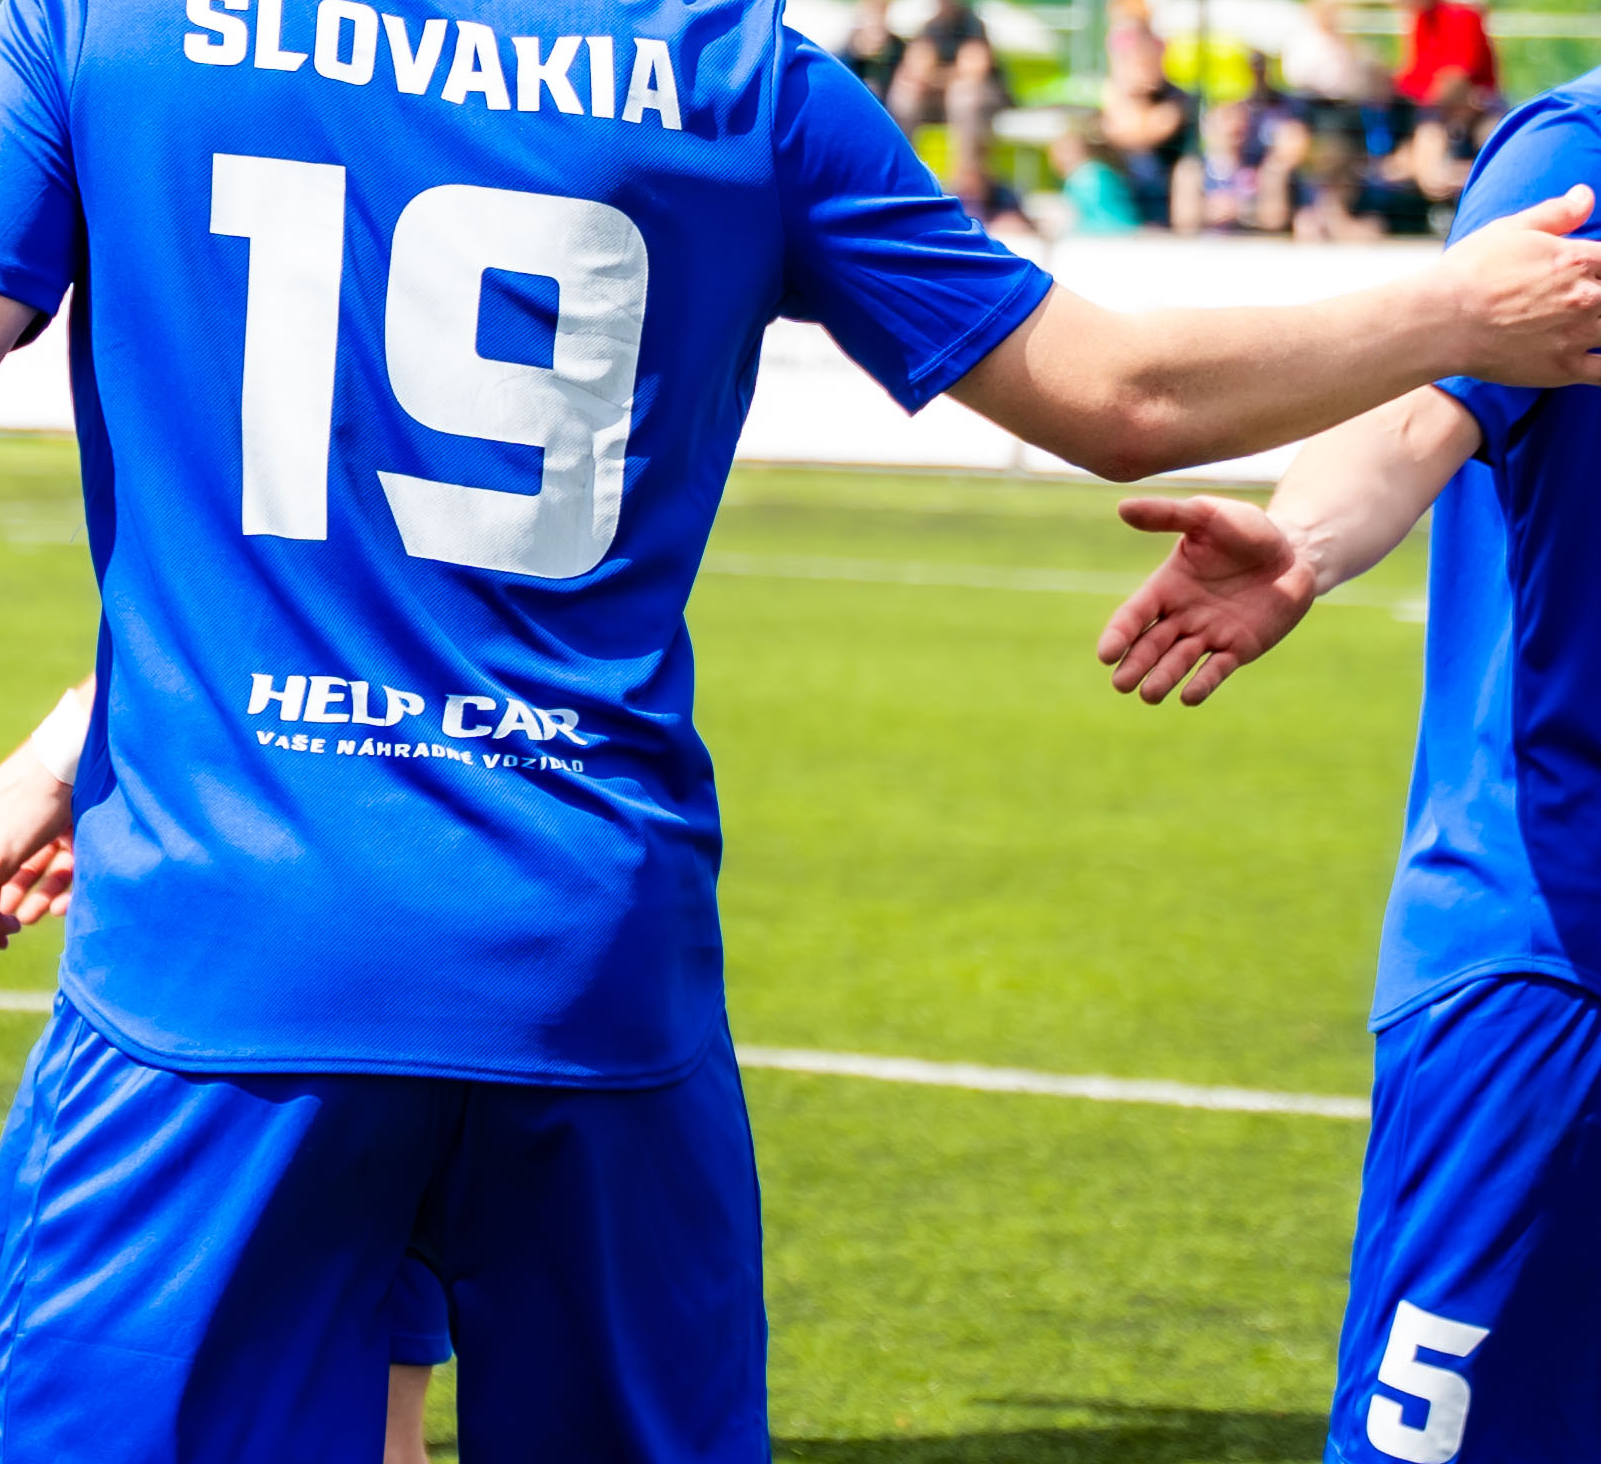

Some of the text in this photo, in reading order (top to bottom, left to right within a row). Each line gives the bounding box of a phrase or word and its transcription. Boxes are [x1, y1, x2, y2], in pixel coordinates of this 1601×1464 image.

[209, 152, 649, 580] 19
[247, 673, 591, 746] HELP CAR
[255, 730, 327, 754] VAŠE
